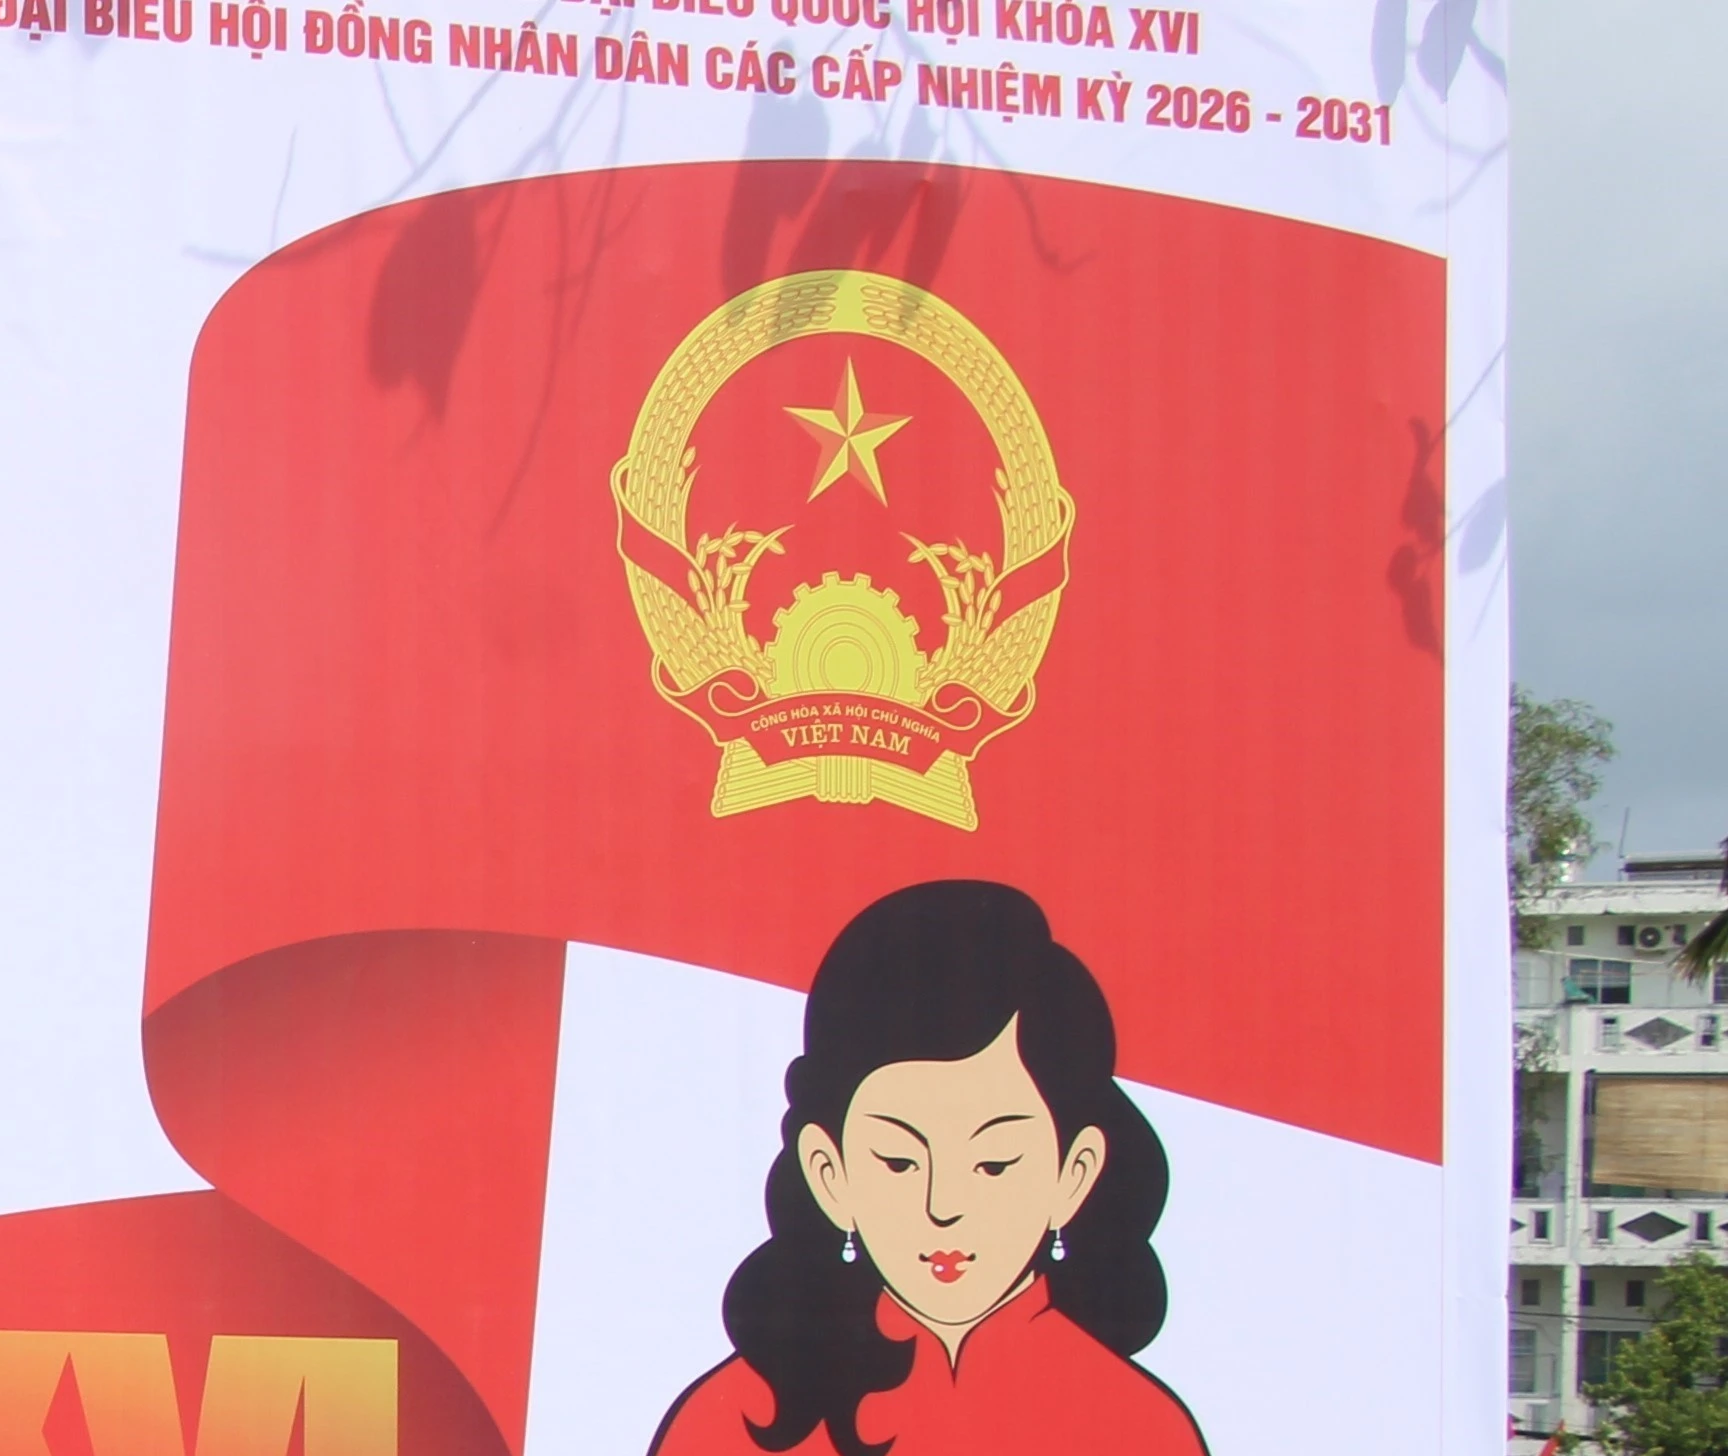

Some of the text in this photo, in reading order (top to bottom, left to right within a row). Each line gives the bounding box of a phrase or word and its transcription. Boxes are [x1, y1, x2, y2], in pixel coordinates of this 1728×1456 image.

[907, 0, 979, 41] HỘI
[996, 0, 1113, 48] KHÓA
[1131, 9, 1198, 54] XVI
[210, 2, 287, 59] HỘI
[304, 9, 432, 64] ĐỒNG
[449, 23, 578, 77] NHÂN
[595, 32, 688, 87] DÂN
[706, 41, 794, 94] CÁC
[813, 50, 902, 101] CẤP
[918, 63, 1060, 122] NHIỆM
[1077, 73, 1131, 123] KỲ
[1146, 85, 1250, 133] 2026
[1266, 113, 1281, 123] -
[1296, 97, 1389, 145] 2031
[750, 702, 941, 743] CỘNG HÒA XÃ HỘI CHỦ NGHĨA
[781, 719, 911, 755] VIỆT NAM
